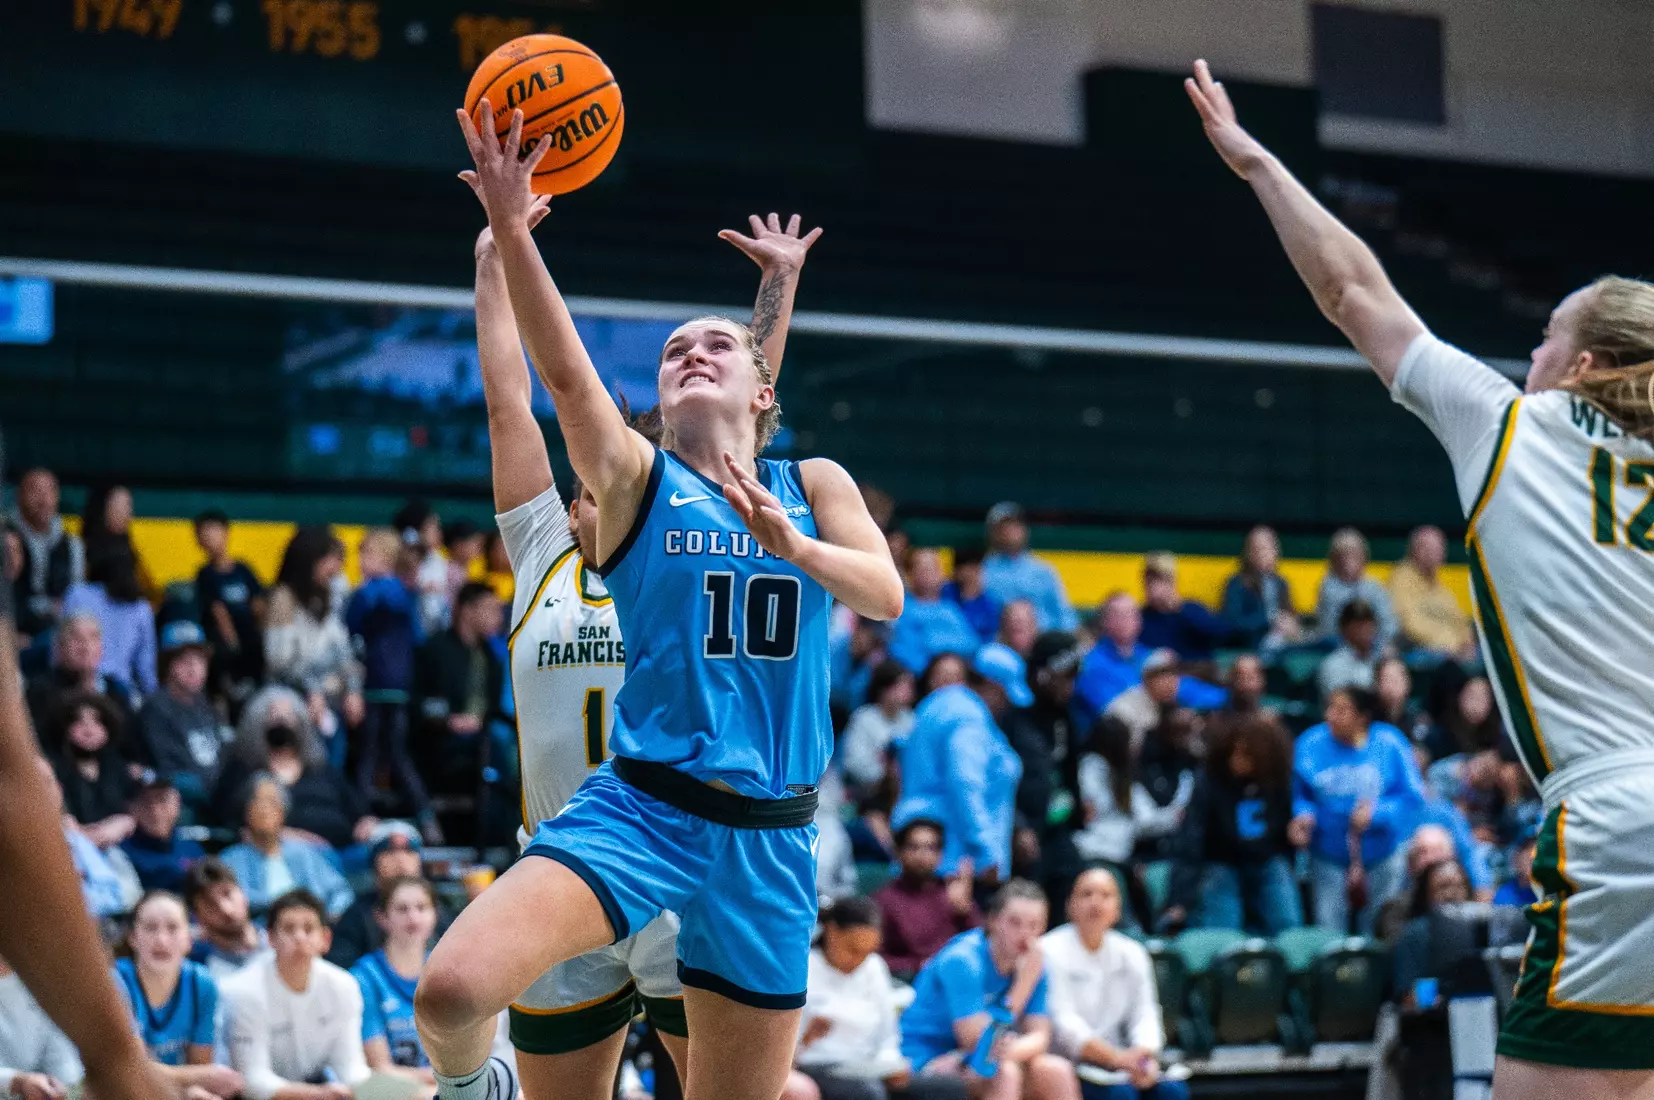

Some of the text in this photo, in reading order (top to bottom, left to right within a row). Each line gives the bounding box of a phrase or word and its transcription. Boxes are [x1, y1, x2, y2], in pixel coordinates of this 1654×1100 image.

[506, 63, 565, 109] EVO
[517, 102, 610, 159] Wilo
[1587, 444, 1654, 554] 12
[578, 626, 610, 639] SAN
[703, 570, 802, 662] 10
[537, 640, 626, 668] FRANCIS
[582, 687, 606, 768] 1
